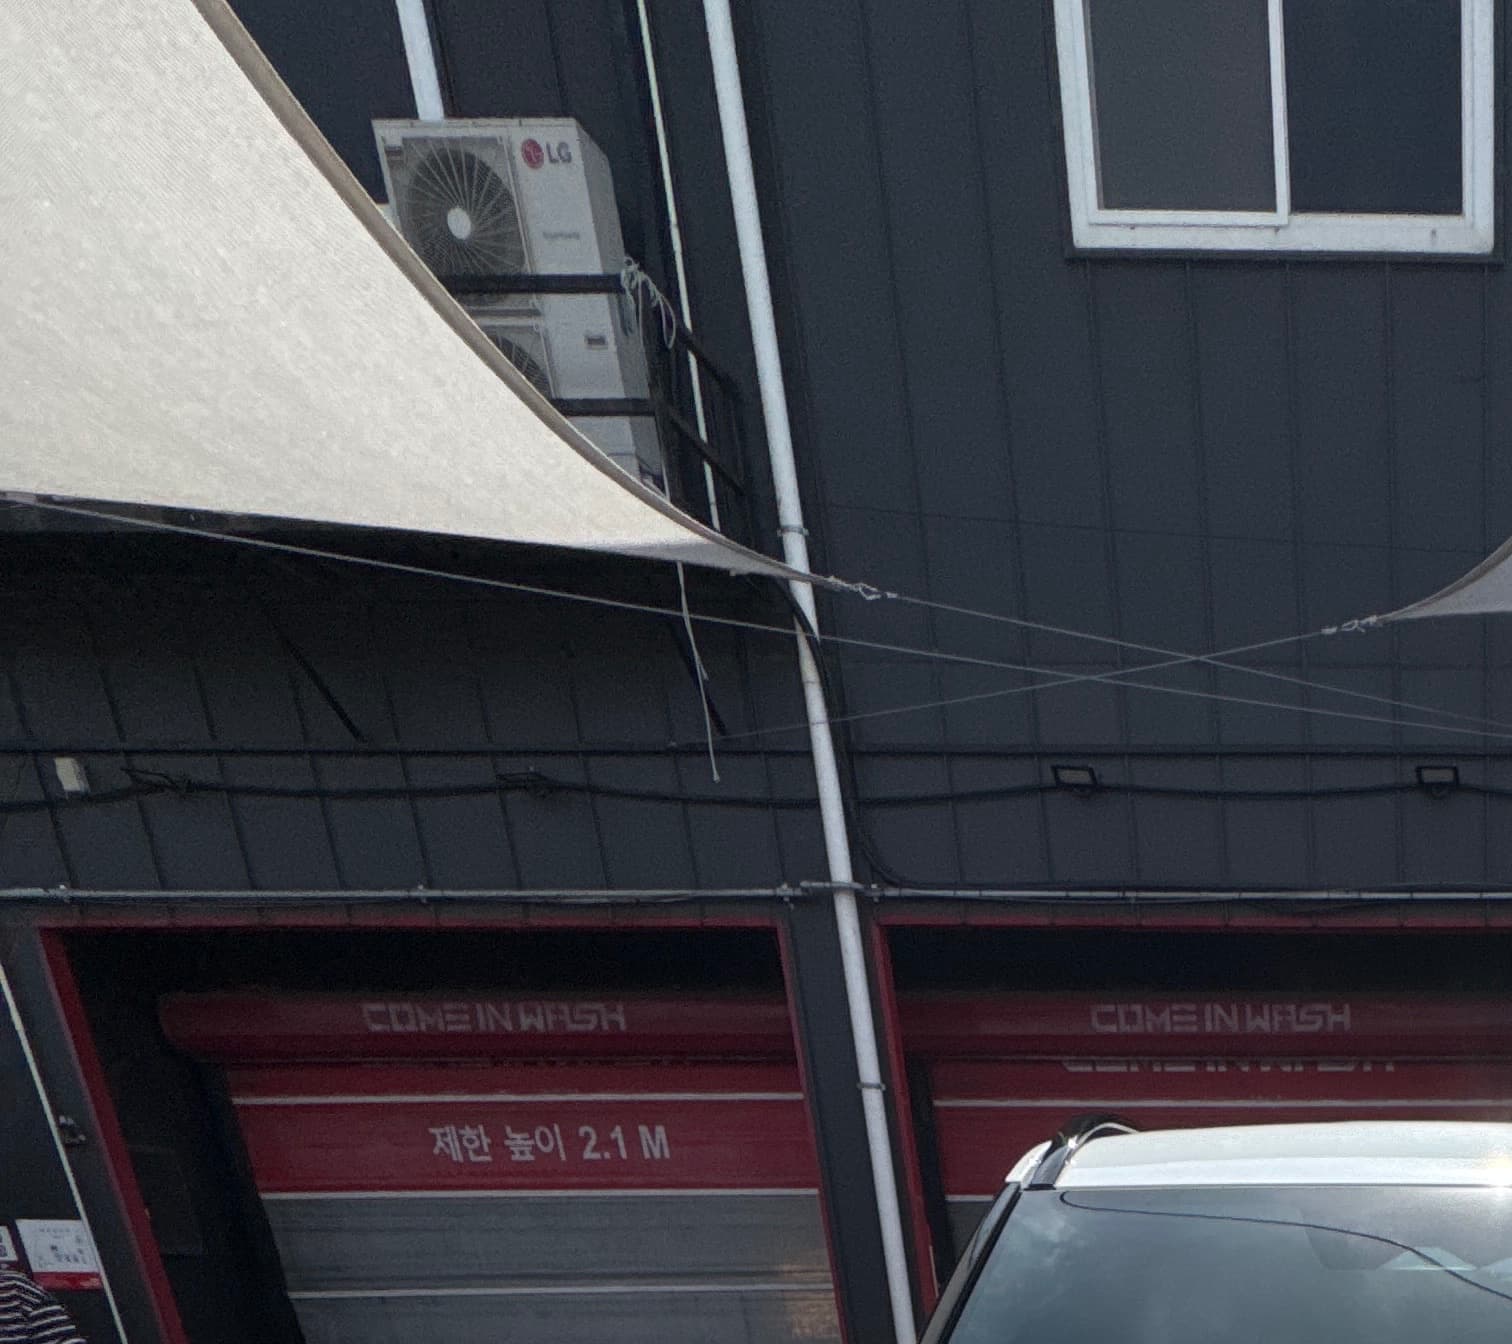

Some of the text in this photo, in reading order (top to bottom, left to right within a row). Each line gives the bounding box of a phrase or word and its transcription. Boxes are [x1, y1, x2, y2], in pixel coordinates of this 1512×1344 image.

[546, 141, 572, 164] LG
[361, 1001, 626, 1033] COME IN WASH
[1090, 1003, 1352, 1033] COME IN WASH
[428, 1123, 671, 1163] 제한 높이 2.1 M
